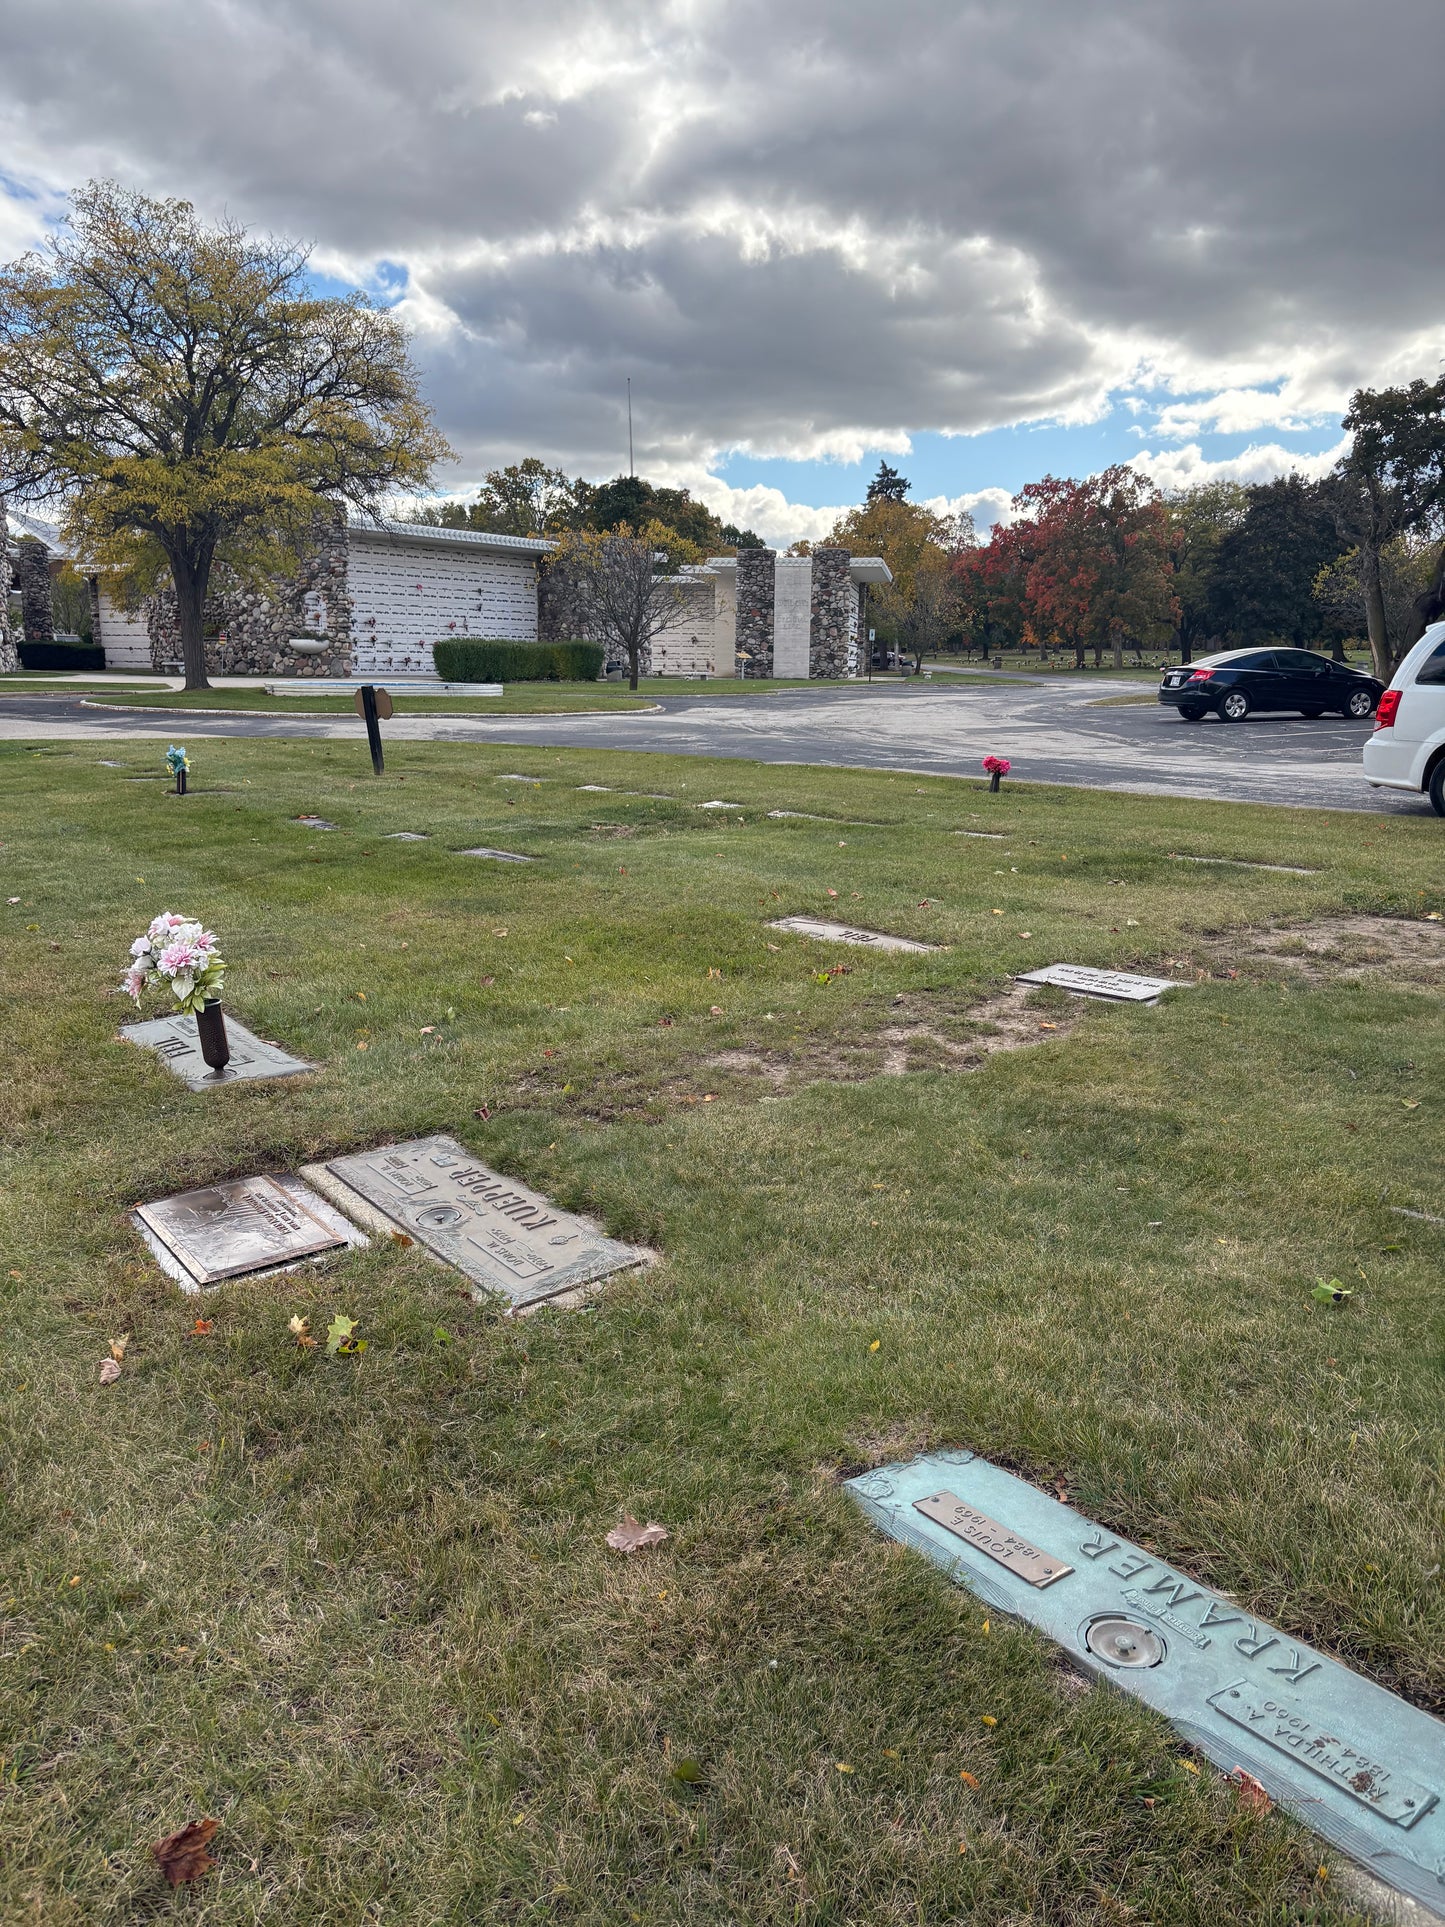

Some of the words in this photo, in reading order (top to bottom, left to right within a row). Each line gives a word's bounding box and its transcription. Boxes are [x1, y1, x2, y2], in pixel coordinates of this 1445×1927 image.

[449, 1165, 558, 1230] KUEPPER
[494, 1247, 525, 1266] DORIS
[953, 1506, 986, 1525] 1969
[962, 1525, 1014, 1559] LOUIS
[1005, 1535, 1041, 1560] 1884
[1078, 1531, 1323, 1685] KRAMER
[1264, 1700, 1311, 1729] 1960
[1274, 1727, 1389, 1800] MTHILDA
[1342, 1747, 1393, 1782] 1884
